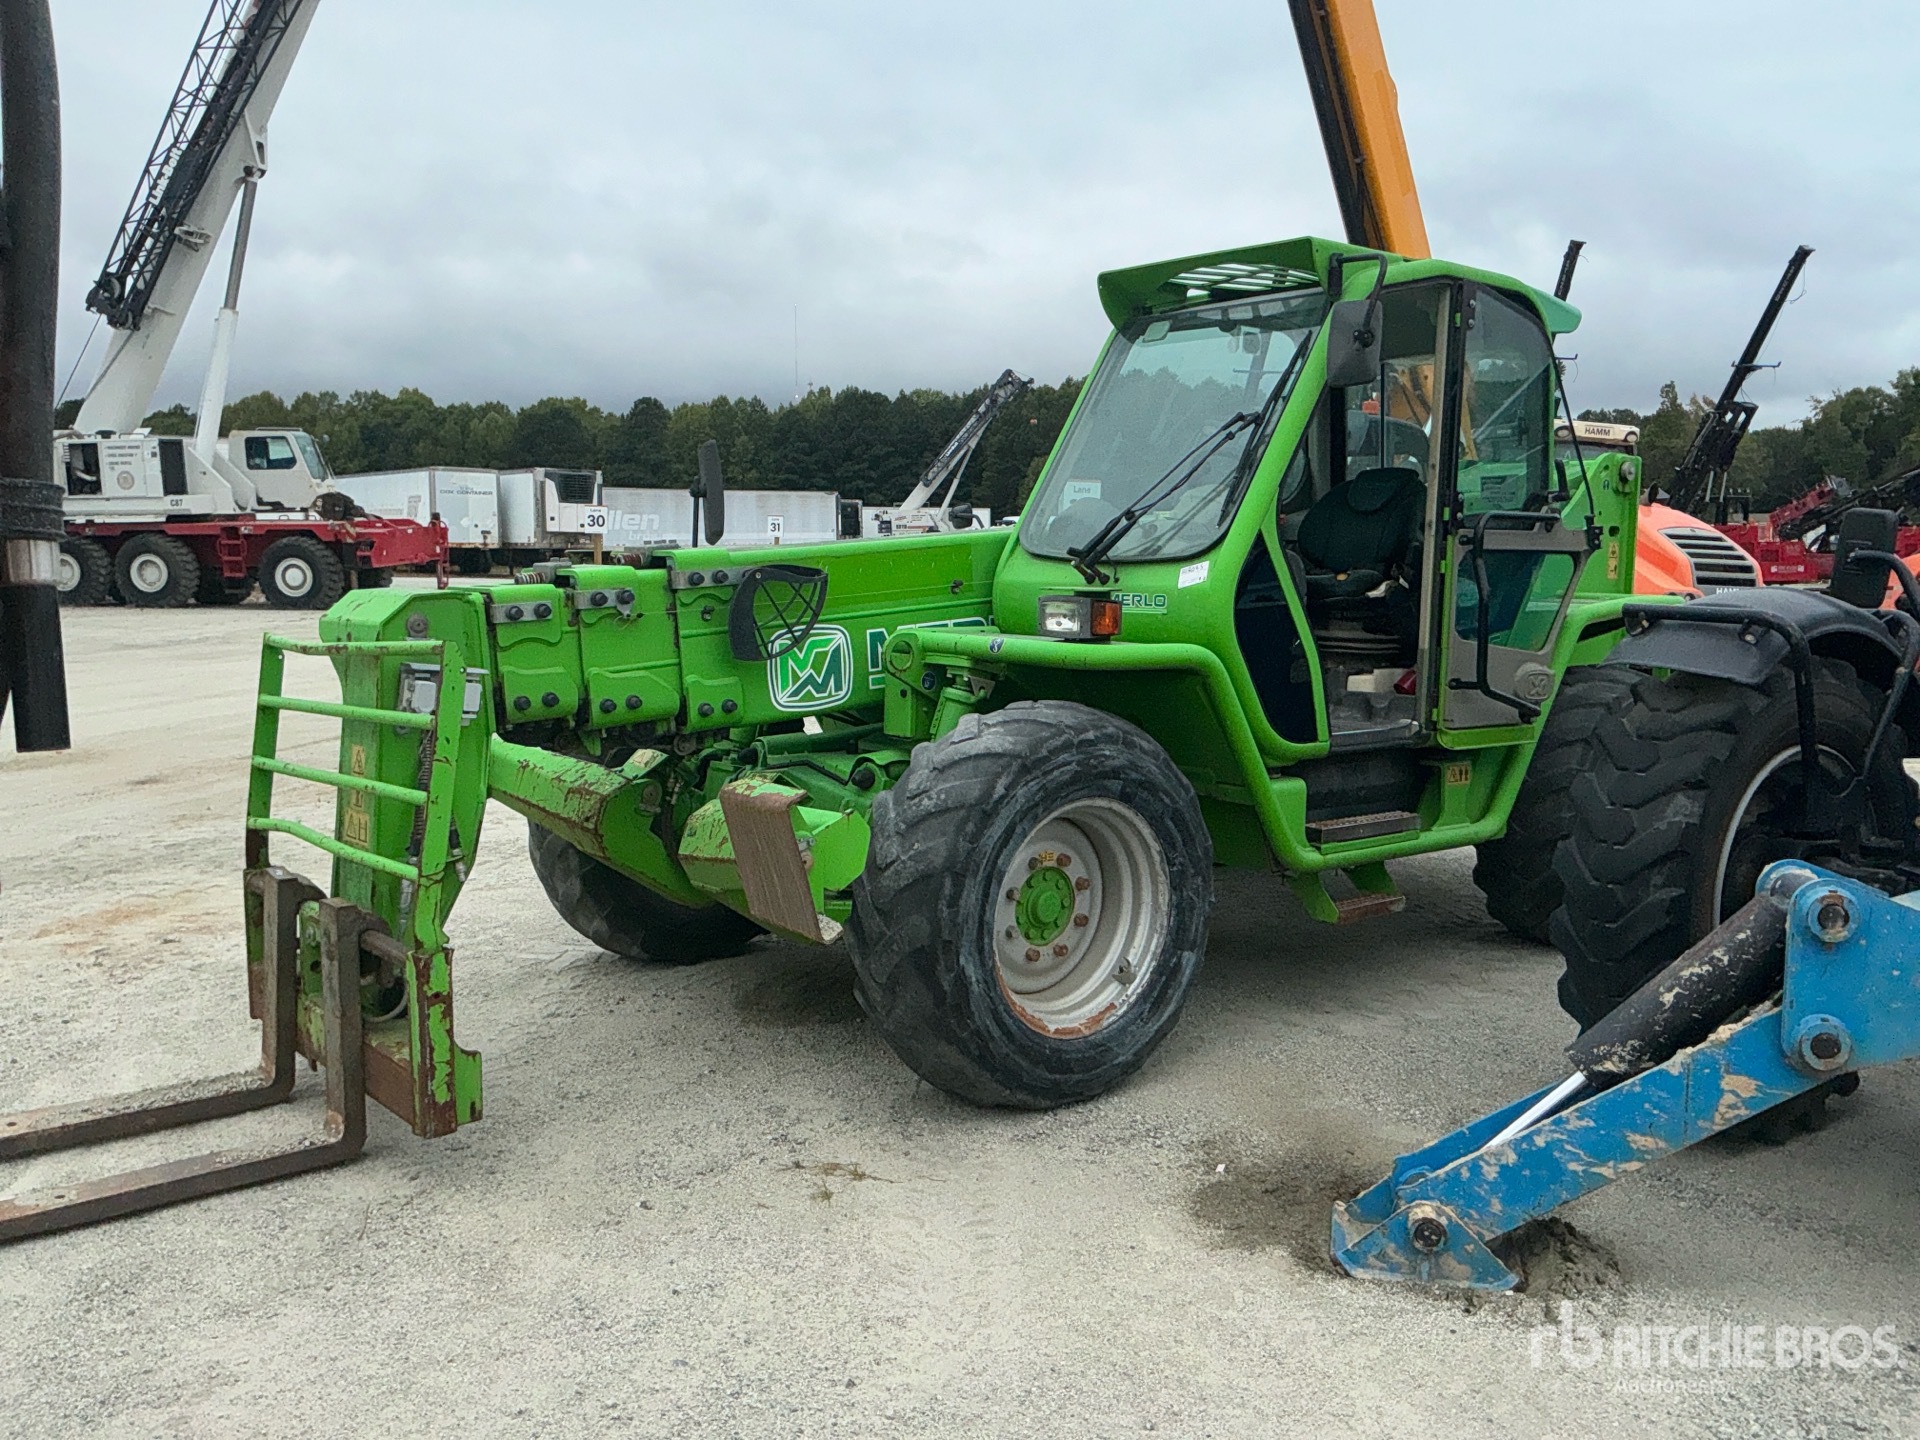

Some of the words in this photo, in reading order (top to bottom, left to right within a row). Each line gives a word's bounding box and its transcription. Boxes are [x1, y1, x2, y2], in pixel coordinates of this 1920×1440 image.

[1584, 426, 1611, 437] HAMM
[587, 514, 606, 527] 30
[607, 509, 660, 531] llen
[770, 522, 780, 532] 31
